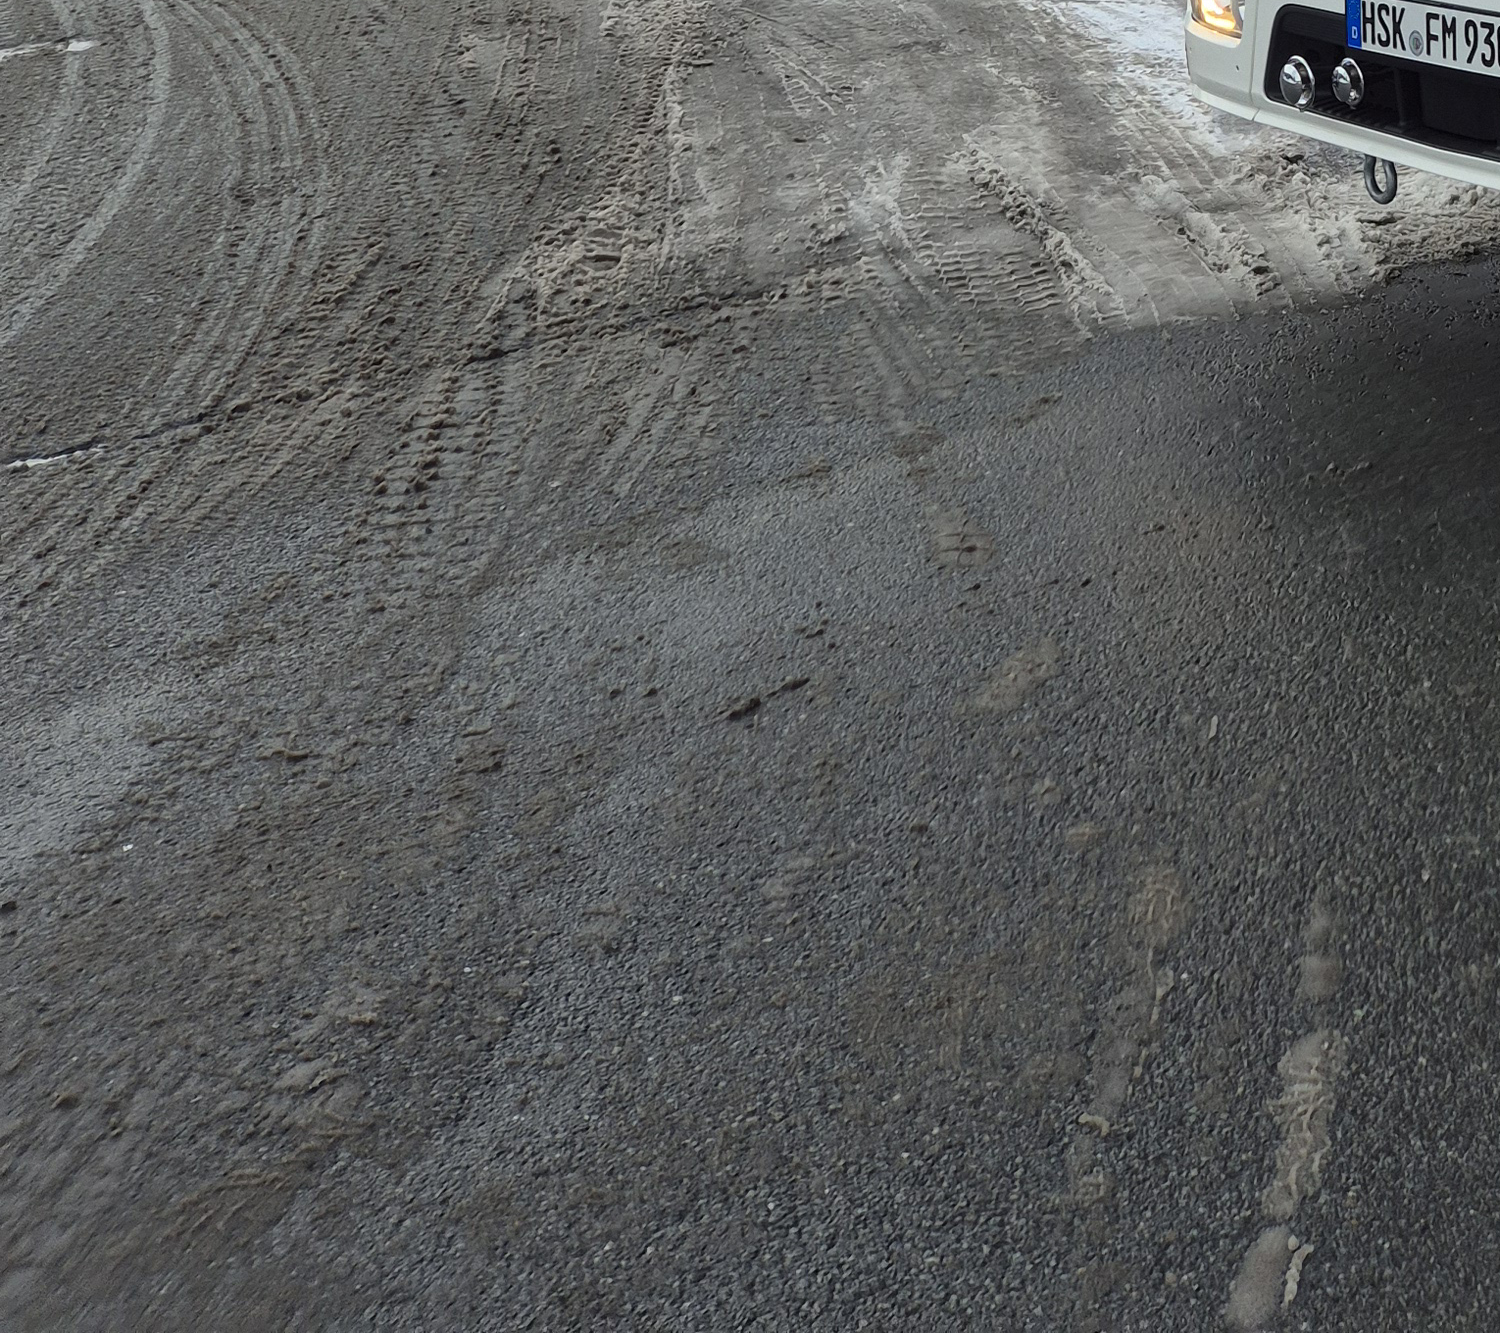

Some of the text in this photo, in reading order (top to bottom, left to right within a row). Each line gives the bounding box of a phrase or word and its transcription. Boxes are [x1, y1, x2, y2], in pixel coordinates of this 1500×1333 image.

[1351, 25, 1359, 39] D
[1361, 0, 1407, 52] HSK
[1425, 12, 1458, 62] FM
